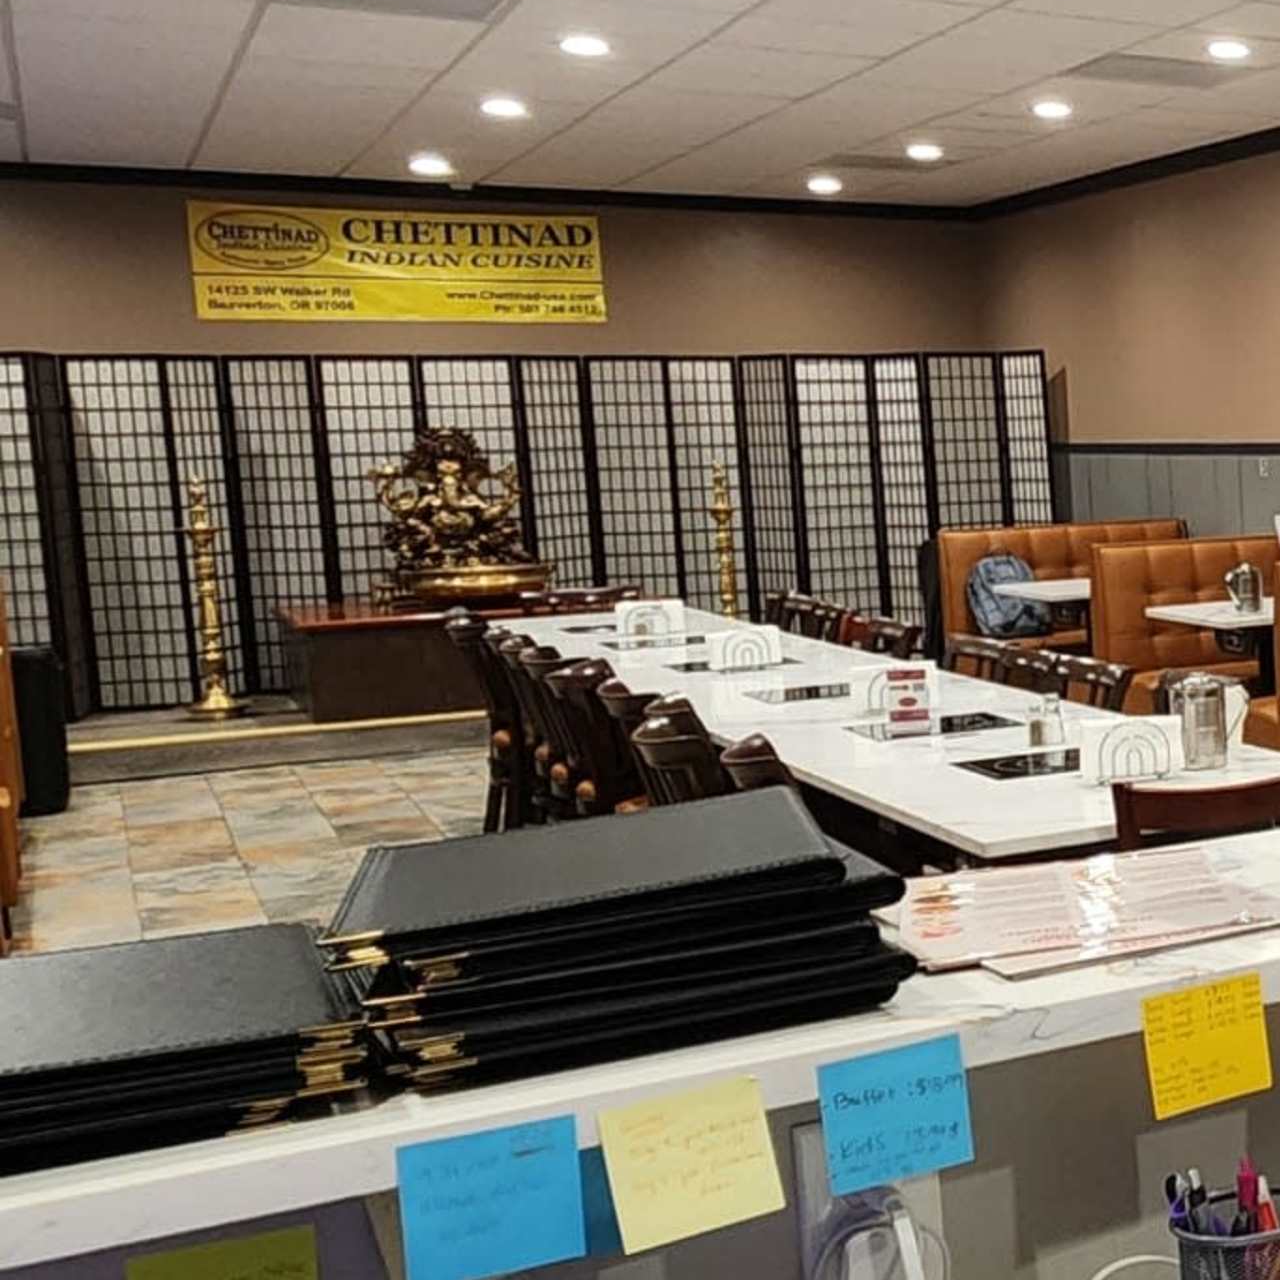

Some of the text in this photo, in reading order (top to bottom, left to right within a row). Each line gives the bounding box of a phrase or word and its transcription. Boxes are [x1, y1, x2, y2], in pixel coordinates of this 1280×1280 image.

[342, 218, 592, 249] CHETTINAD
[346, 249, 595, 270] INDIAN CUISINE
[252, 285, 276, 296] SW
[331, 286, 351, 297] Rd
[289, 300, 311, 310] OR
